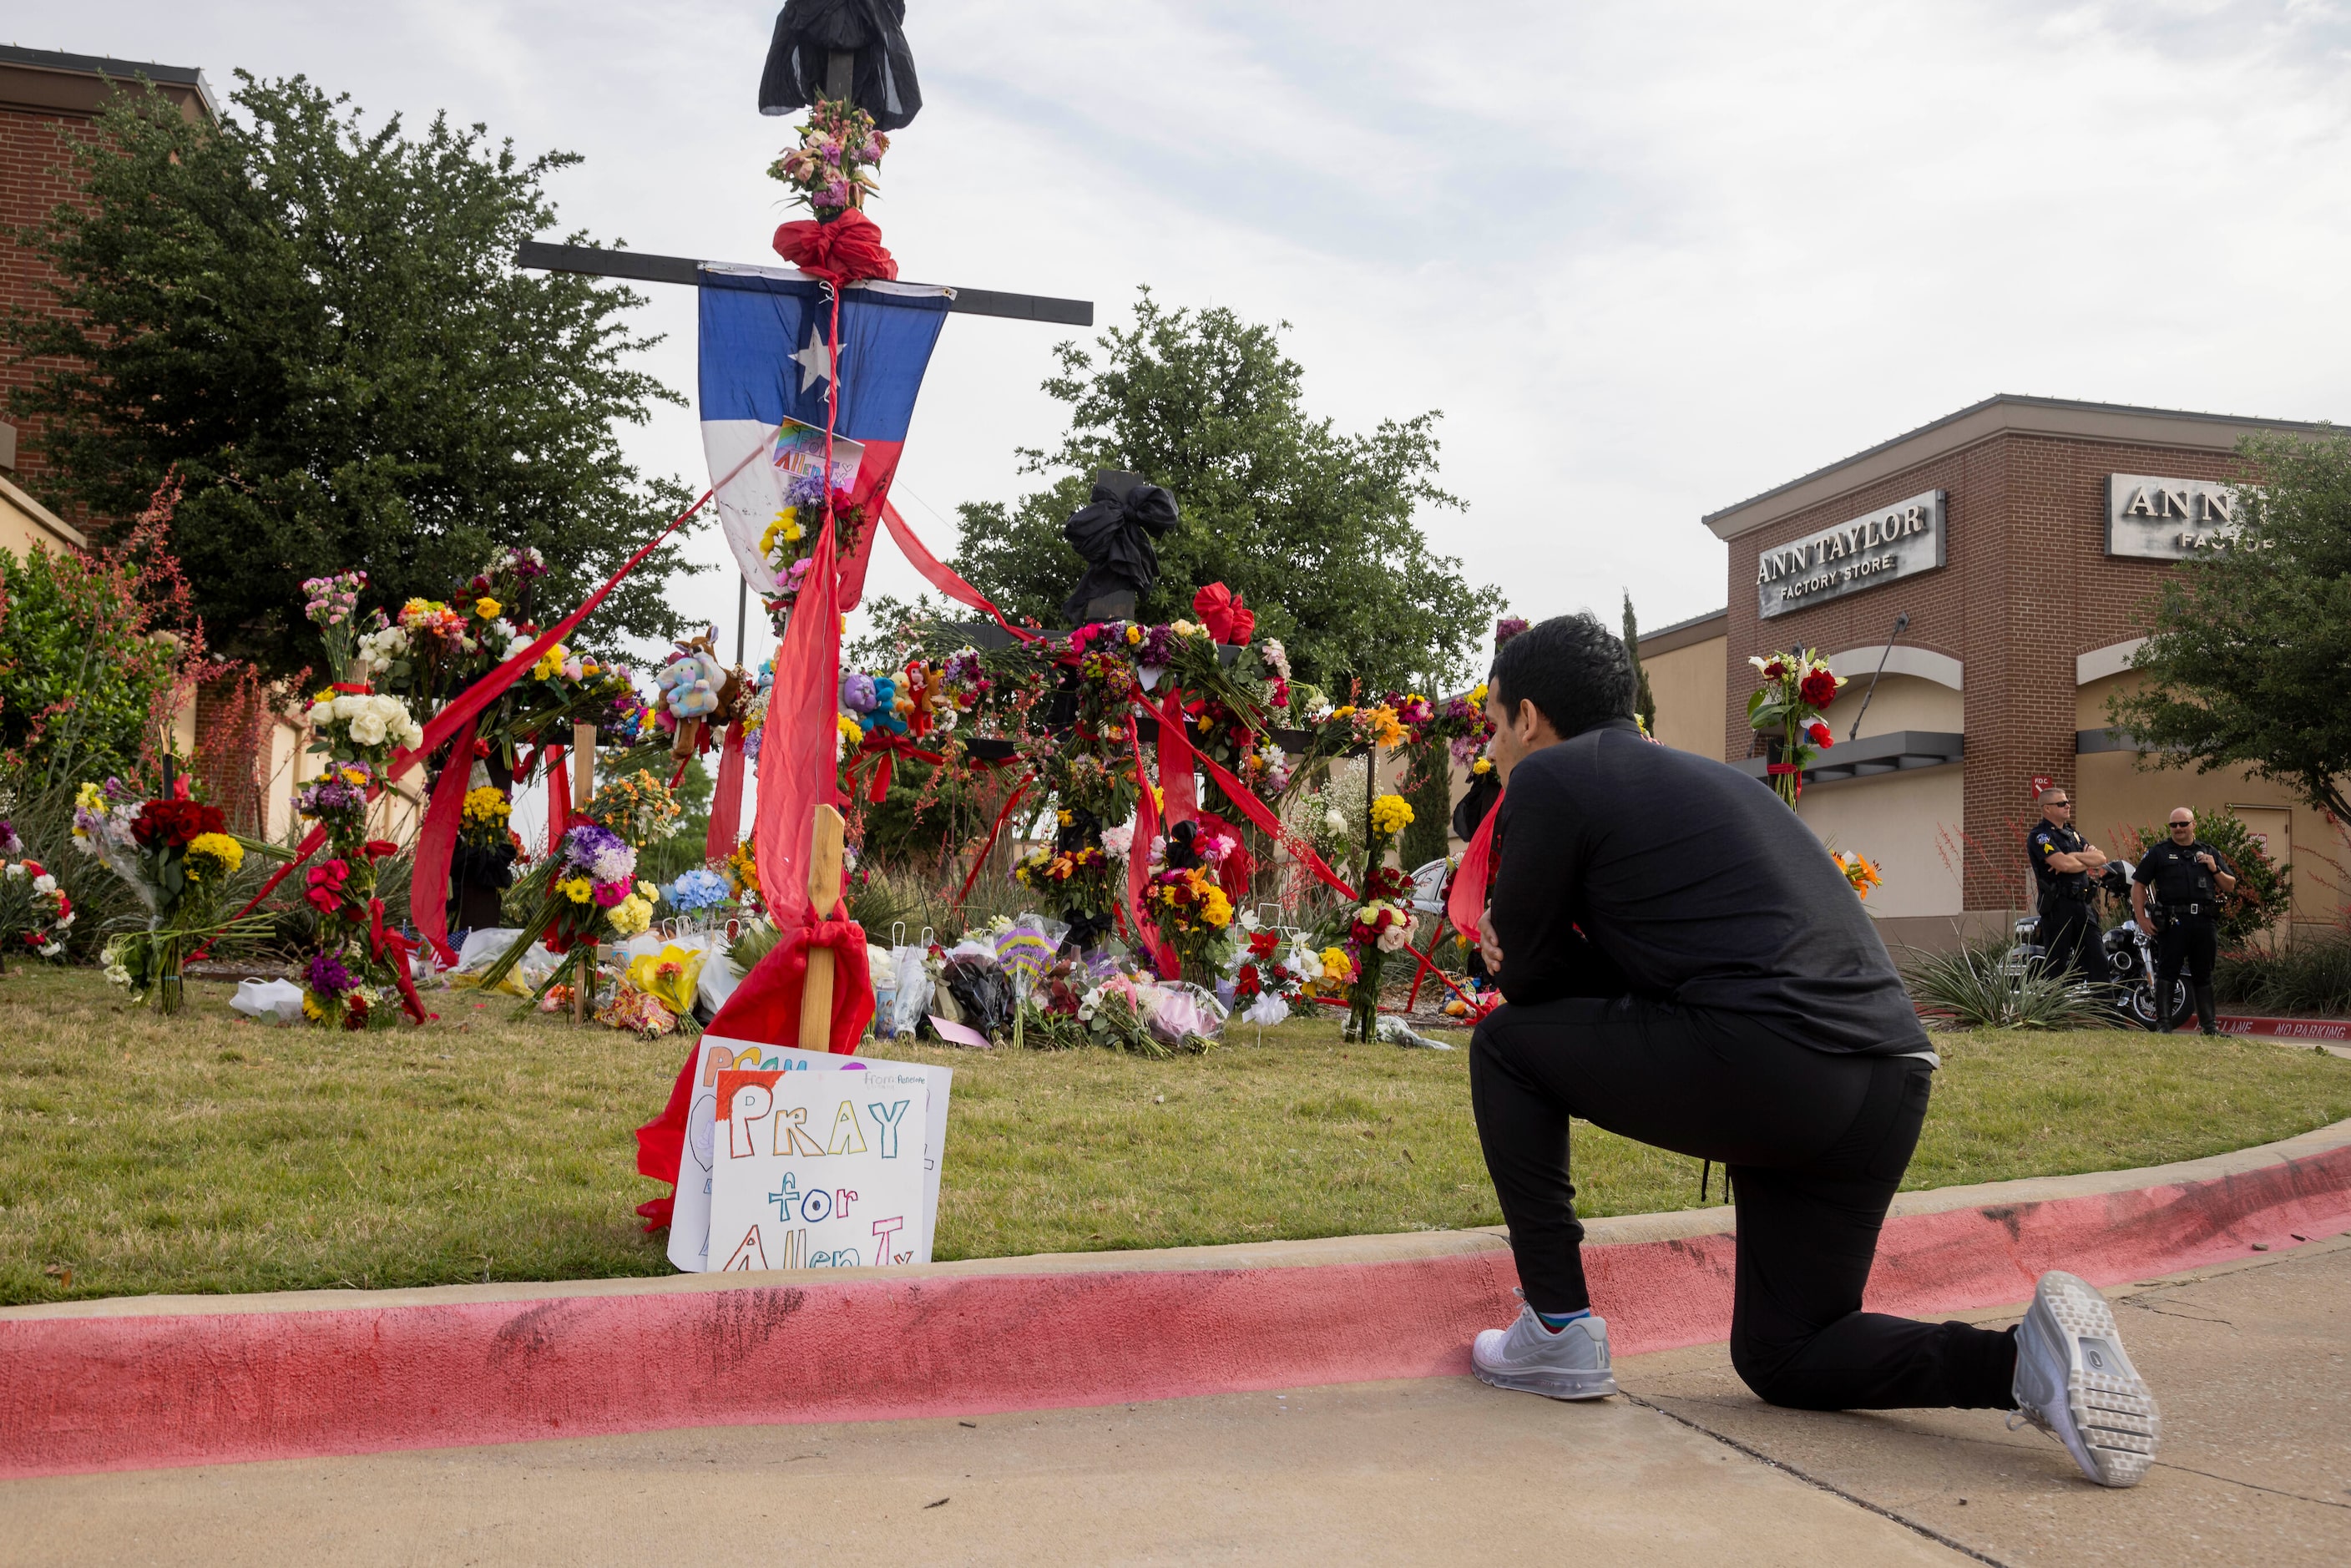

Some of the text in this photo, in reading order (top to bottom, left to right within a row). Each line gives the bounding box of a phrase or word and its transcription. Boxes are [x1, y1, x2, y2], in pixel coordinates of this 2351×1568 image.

[775, 451, 822, 478] Allen
[2126, 487, 2231, 522] ANN
[1757, 504, 1924, 584] ANN TAYLOR
[1781, 554, 1892, 600] FACTORY STORE
[2221, 1020, 2253, 1034] LANE
[2274, 1023, 2293, 1036] NO
[2293, 1024, 2346, 1039] PARKING
[728, 1082, 911, 1159] PRAY
[768, 1171, 859, 1222] for
[723, 1224, 860, 1272] Allen
